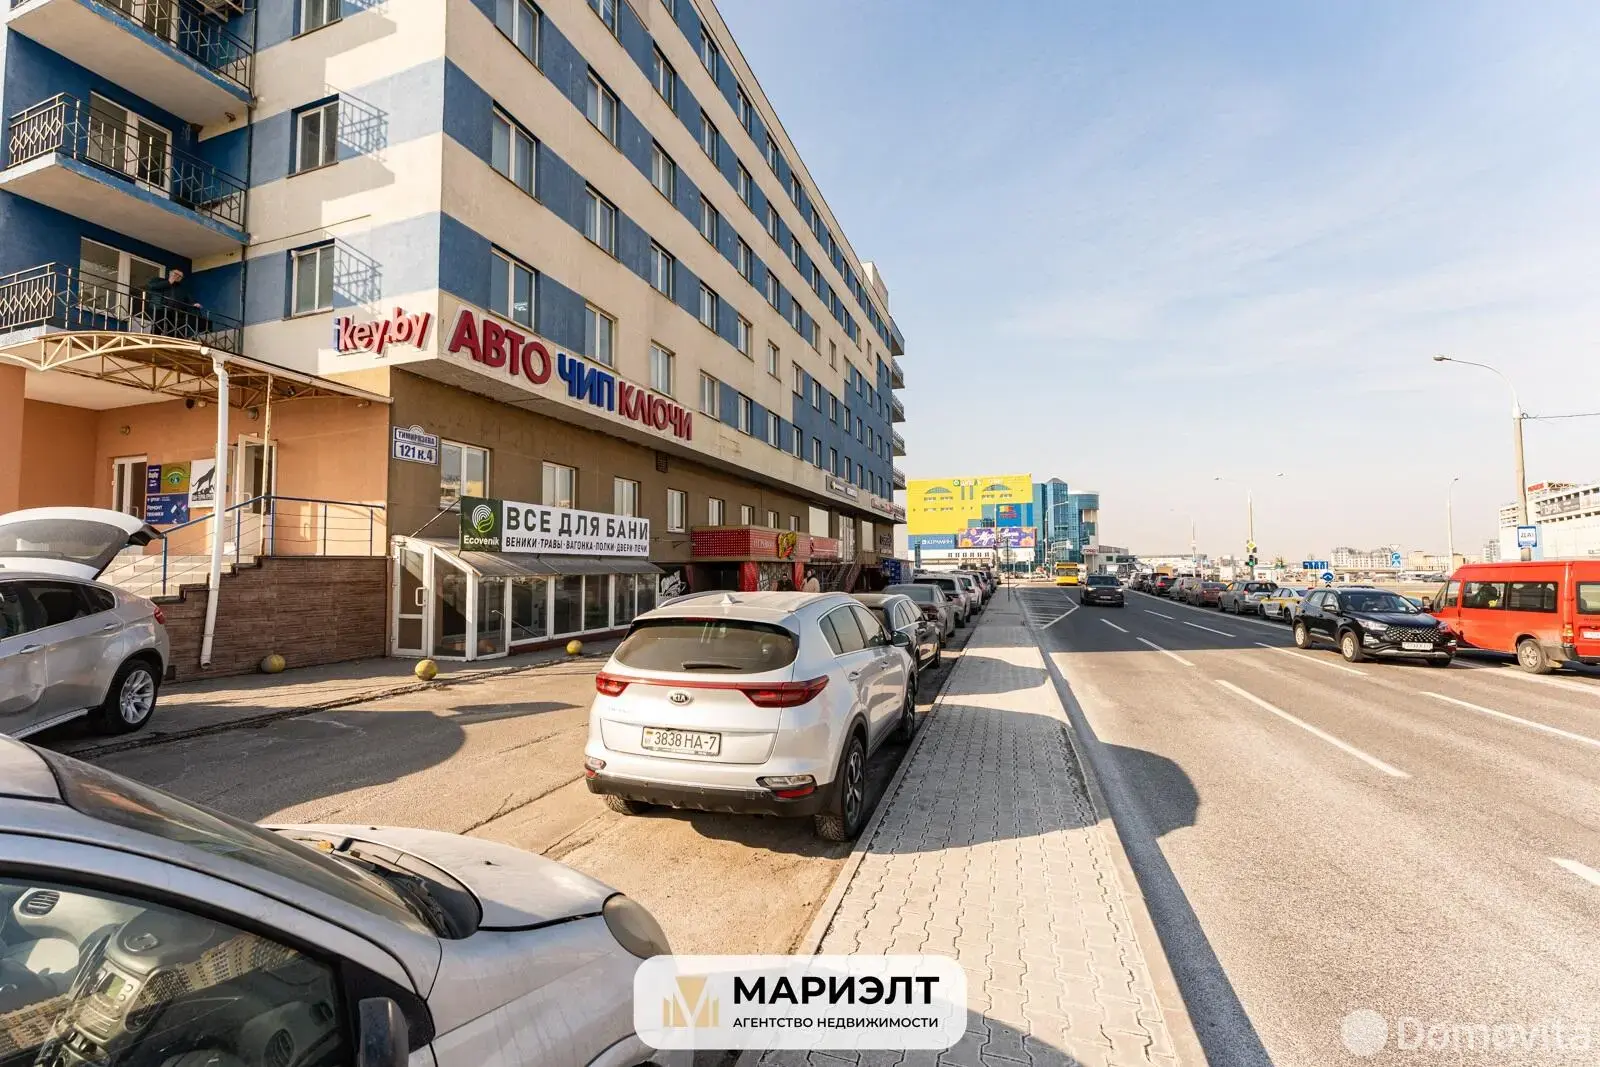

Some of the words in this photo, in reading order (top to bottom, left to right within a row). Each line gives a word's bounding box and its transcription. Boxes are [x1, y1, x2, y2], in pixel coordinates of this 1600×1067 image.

[332, 307, 431, 354] ikey.by
[448, 310, 552, 384] АВТО
[557, 353, 615, 412] ЧИП
[618, 381, 693, 441] КЛЮЧИ
[399, 445, 416, 458] 121
[506, 507, 552, 532] ВСЕ
[558, 513, 600, 537] ДЛЯ
[606, 518, 649, 541] БАНИ
[463, 535, 500, 546] Ecovenik
[505, 536, 538, 548] ВЕНИКИ
[541, 538, 563, 549] ТРАВЫ
[566, 540, 593, 551] ВАГОНКА
[595, 542, 615, 551] ПОЛКИ
[671, 693, 688, 702] KIA
[654, 731, 683, 747] 3838
[684, 733, 718, 750] HA-7
